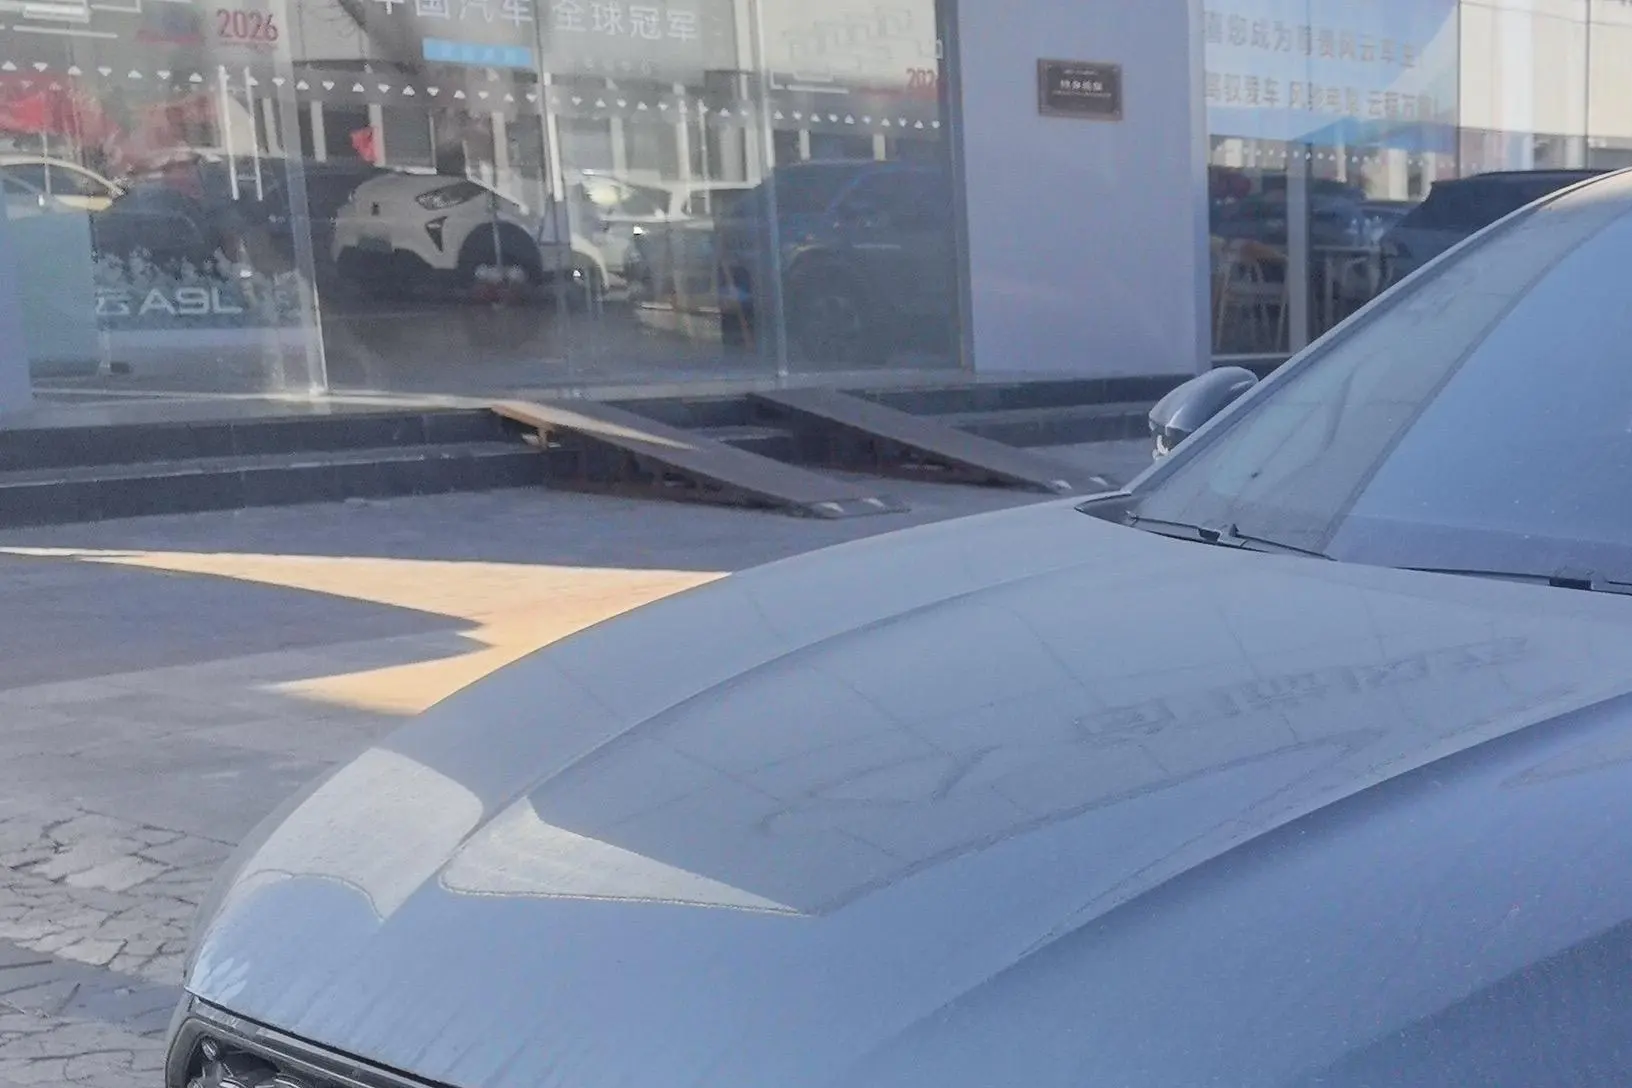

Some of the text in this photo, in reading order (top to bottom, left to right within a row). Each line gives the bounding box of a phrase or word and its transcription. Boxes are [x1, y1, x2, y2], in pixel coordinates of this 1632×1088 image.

[217, 8, 279, 41] 2026
[551, 1, 698, 41] 全球冠军
